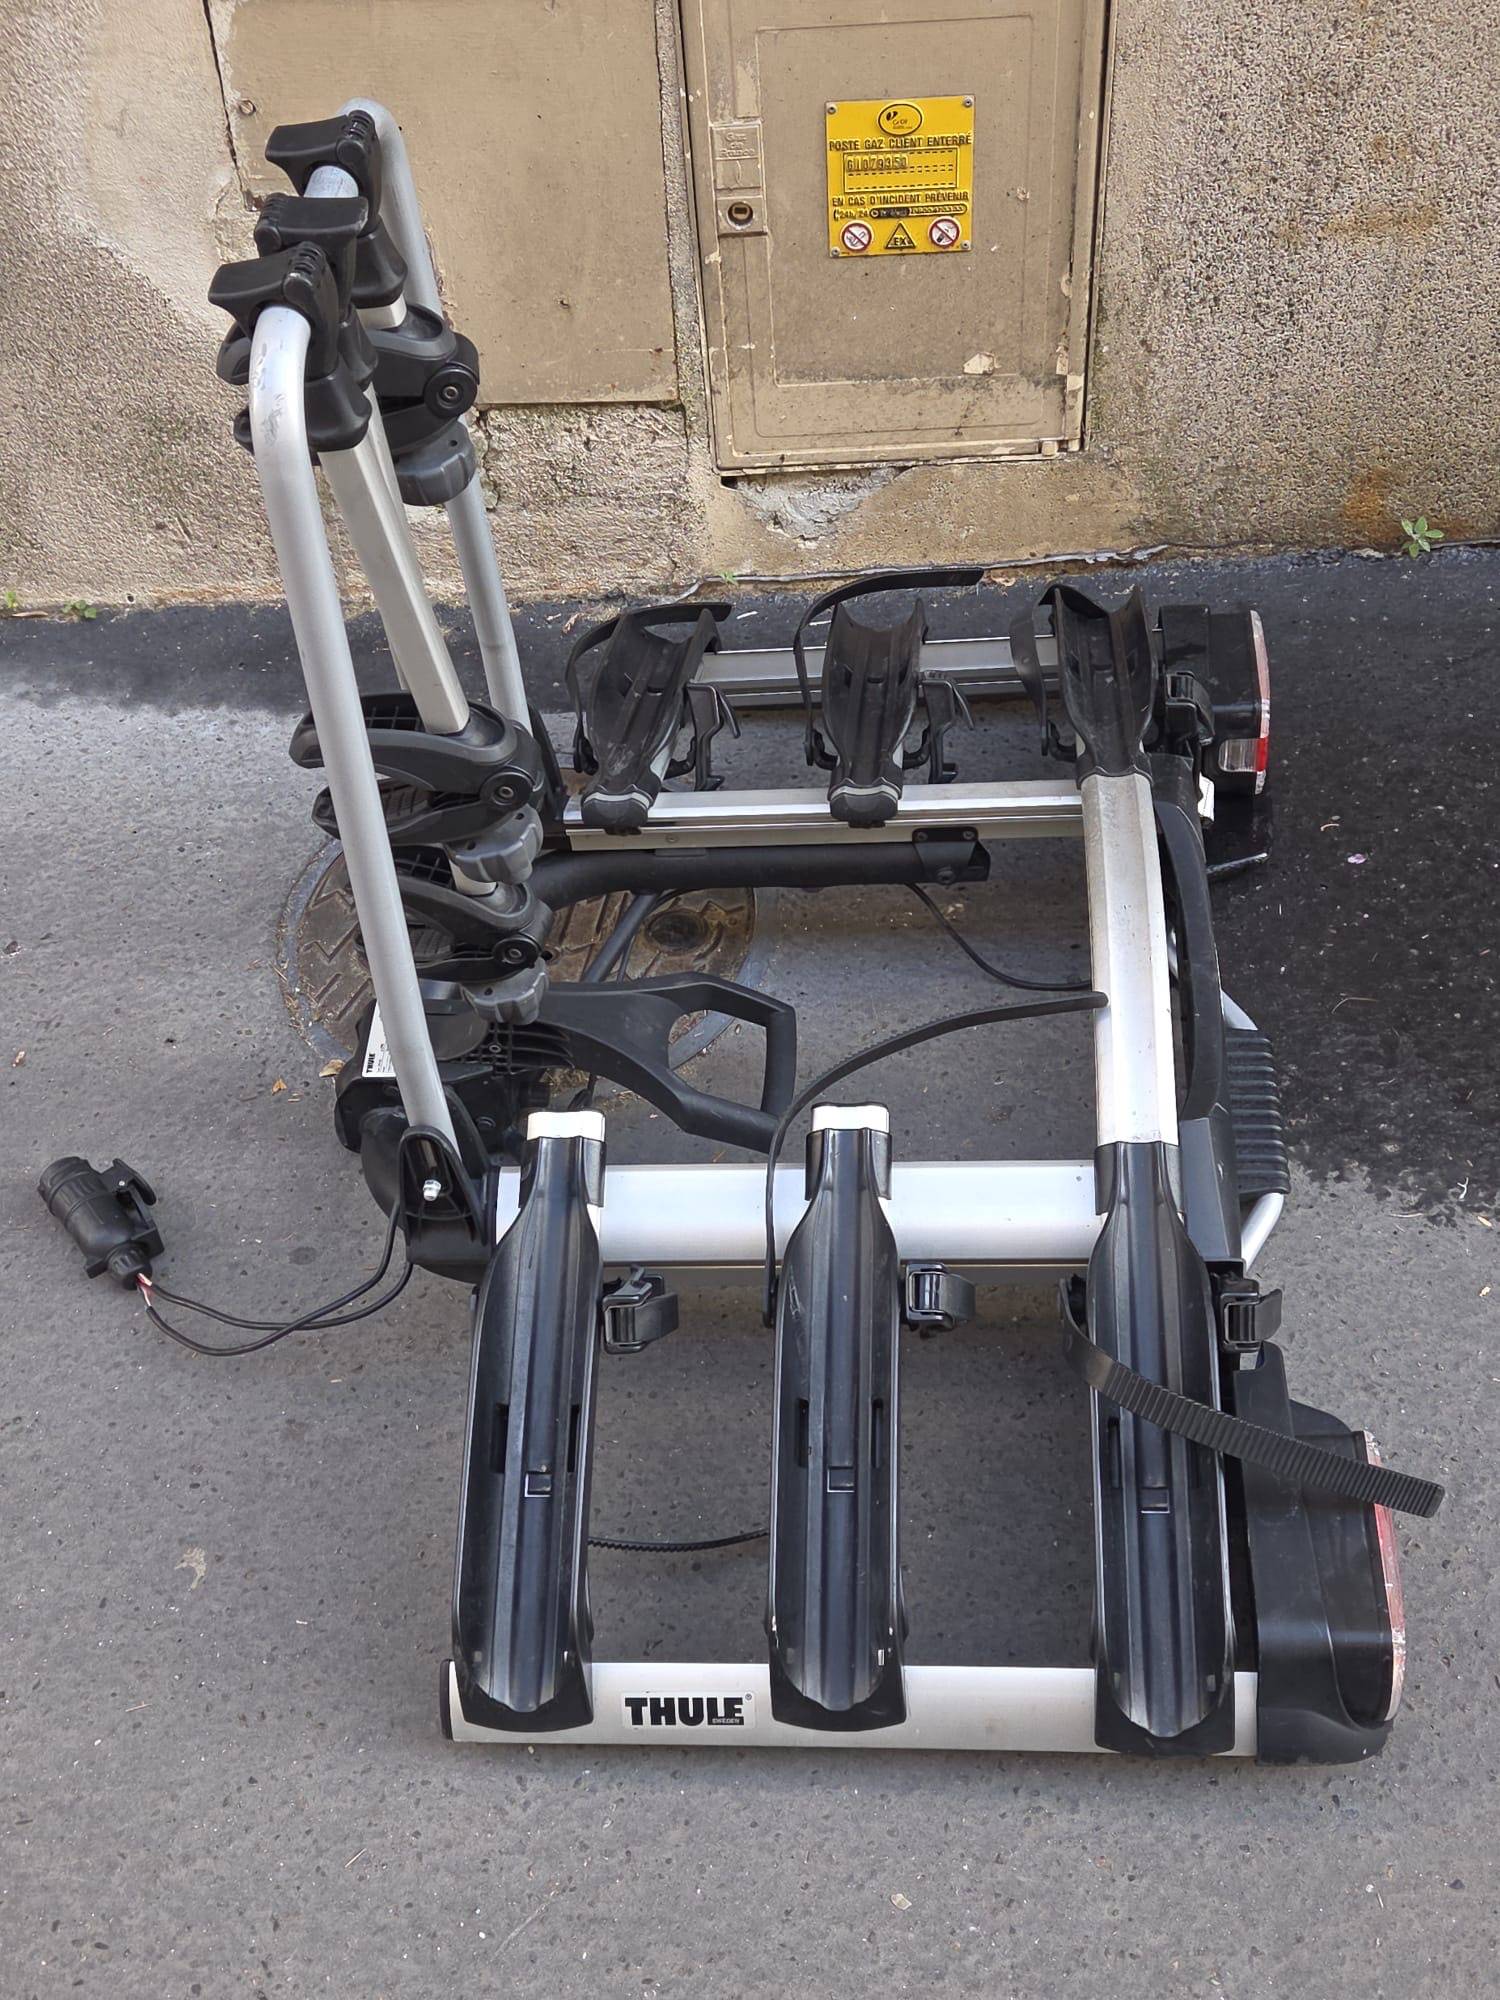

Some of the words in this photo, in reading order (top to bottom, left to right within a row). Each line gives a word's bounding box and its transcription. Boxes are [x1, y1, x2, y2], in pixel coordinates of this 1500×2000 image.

[829, 138, 860, 151] POSTE
[864, 137, 885, 149] GAZ
[889, 136, 923, 148] CLIENT
[928, 133, 971, 146] ENTERRÉ
[832, 196, 844, 207] EN
[848, 195, 865, 206] CAS
[869, 193, 922, 205] D'INCIDENT
[925, 192, 969, 202] PRÉVENIR
[893, 236, 907, 246] EX
[625, 1697, 745, 1726] THULE
